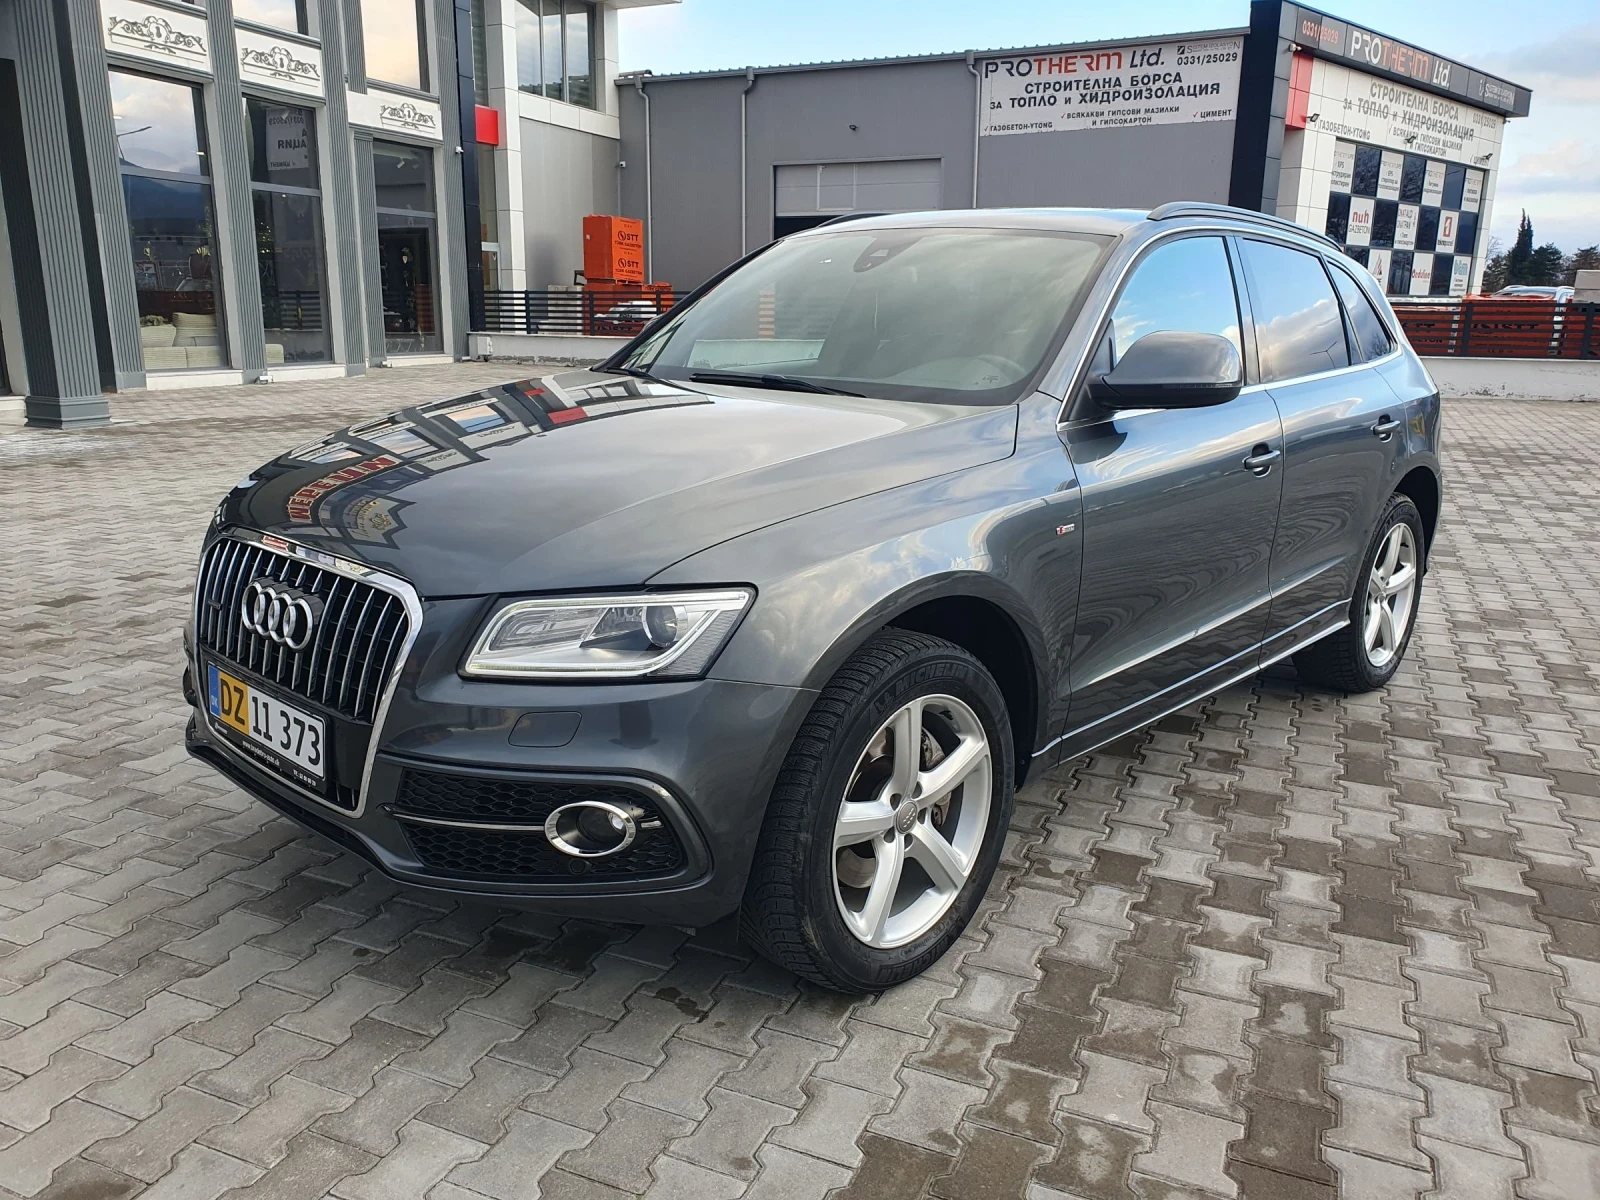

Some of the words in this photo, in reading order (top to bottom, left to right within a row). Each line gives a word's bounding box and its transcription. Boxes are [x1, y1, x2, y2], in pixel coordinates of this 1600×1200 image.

[1302, 20, 1339, 44] 0331/25029
[984, 52, 1122, 79] PROTHERM
[1129, 48, 1165, 69] Ltd.
[1176, 52, 1238, 66] 0331/25029
[1024, 75, 1122, 95] СТРОИТЕЛНА
[1130, 71, 1183, 87] БОРСА
[1432, 60, 1450, 87] Ltd.
[989, 101, 1002, 110] ЗА
[1009, 95, 1057, 109] ТОПЛО
[1078, 82, 1220, 105] ХИДРОИЗОЛАЦИЯ
[1370, 81, 1429, 113] СТРОИТЕЛНА
[1432, 101, 1459, 121] БОРСА
[1066, 110, 1105, 119] ВСЯКАКВИ
[1107, 108, 1141, 118] ГИПСОВИ
[1144, 106, 1180, 115] МАЗИЛКИ
[1100, 117, 1152, 126] ГИПСОКАРТОН
[1200, 109, 1232, 119] ЦИМЕНТ
[1343, 98, 1352, 111] ЗА
[1357, 98, 1389, 120] ТОПЛО
[1401, 109, 1475, 142] ХИДРОИЗОЛАЦИЯ
[1352, 209, 1370, 224] nuh
[626, 233, 639, 242] STT
[627, 260, 639, 269] STT
[895, 662, 969, 698] MICHELIN
[220, 677, 246, 726] DZ
[251, 695, 273, 743] 11
[280, 709, 321, 766] 373
